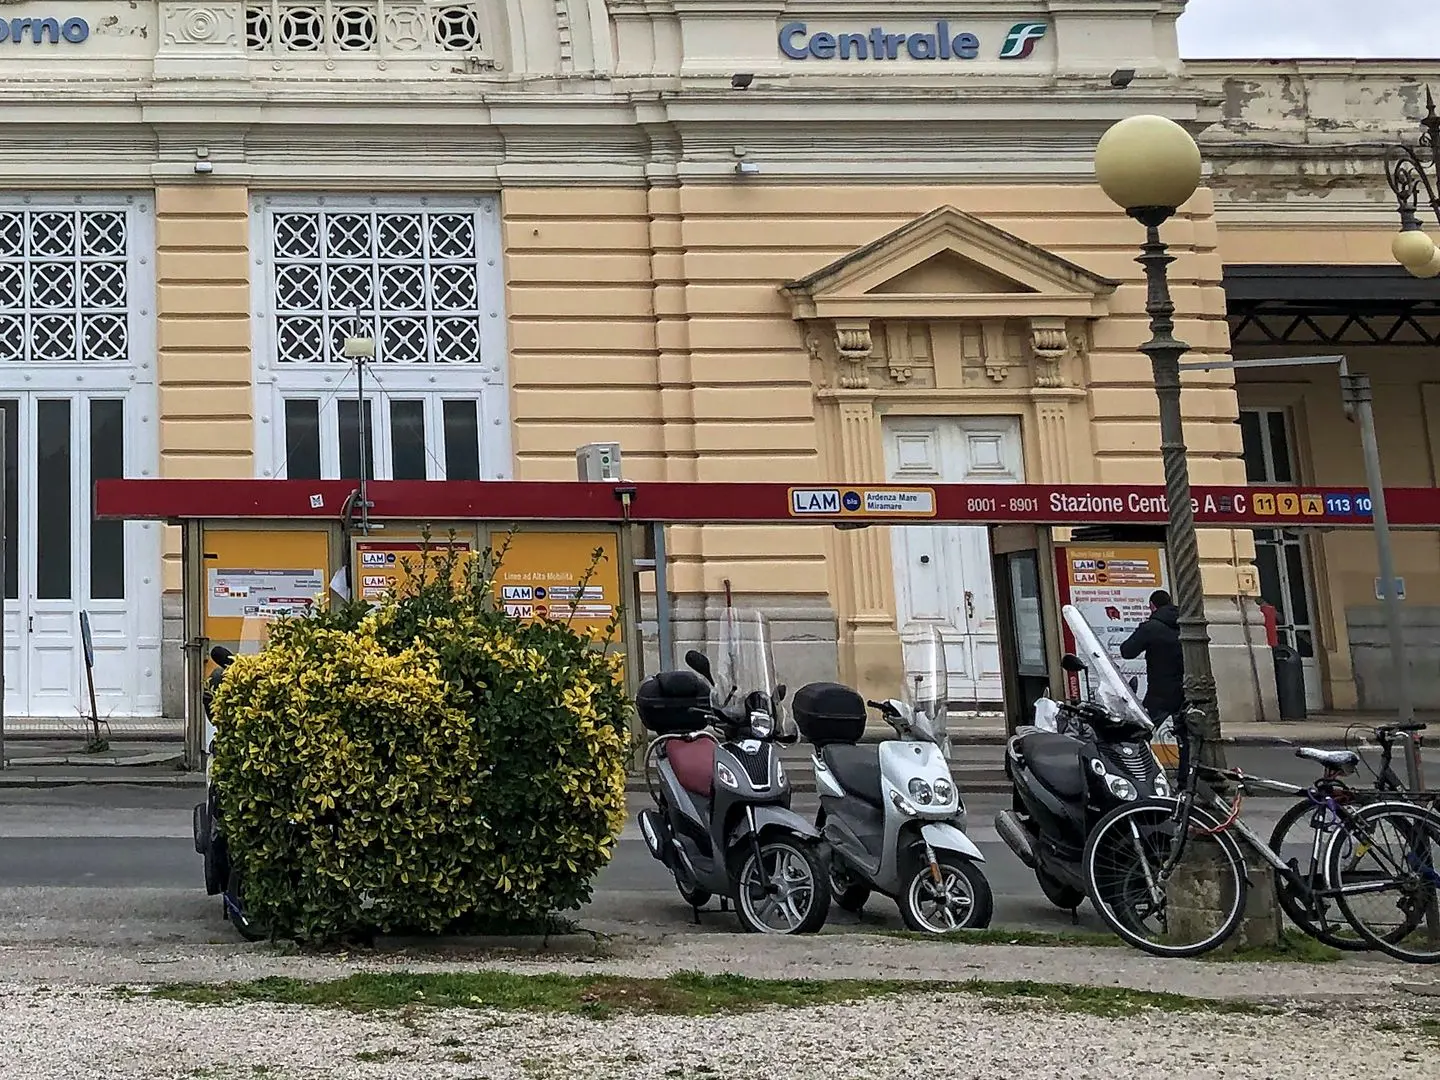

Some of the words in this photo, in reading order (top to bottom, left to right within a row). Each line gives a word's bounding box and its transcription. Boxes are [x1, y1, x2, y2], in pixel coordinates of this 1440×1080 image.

[778, 20, 981, 60] Centrale
[796, 493, 837, 510] LAM
[867, 493, 897, 502] Ardenza
[898, 493, 918, 502] Mare
[1049, 493, 1123, 512] Stazione
[1203, 494, 1218, 513] A
[1234, 494, 1247, 513] C
[867, 502, 902, 510] Miramare
[967, 498, 996, 512] 8001
[1010, 498, 1038, 512] 8901
[1257, 498, 1273, 510] 11
[1284, 498, 1293, 510] 9
[1307, 500, 1319, 512] A
[1326, 499, 1351, 512] 113
[363, 554, 384, 563] LAM
[1073, 561, 1094, 569] LAM
[364, 577, 385, 586] LAM
[1075, 574, 1095, 582] LAM
[504, 588, 530, 599] LAM
[504, 606, 532, 617] LAM
